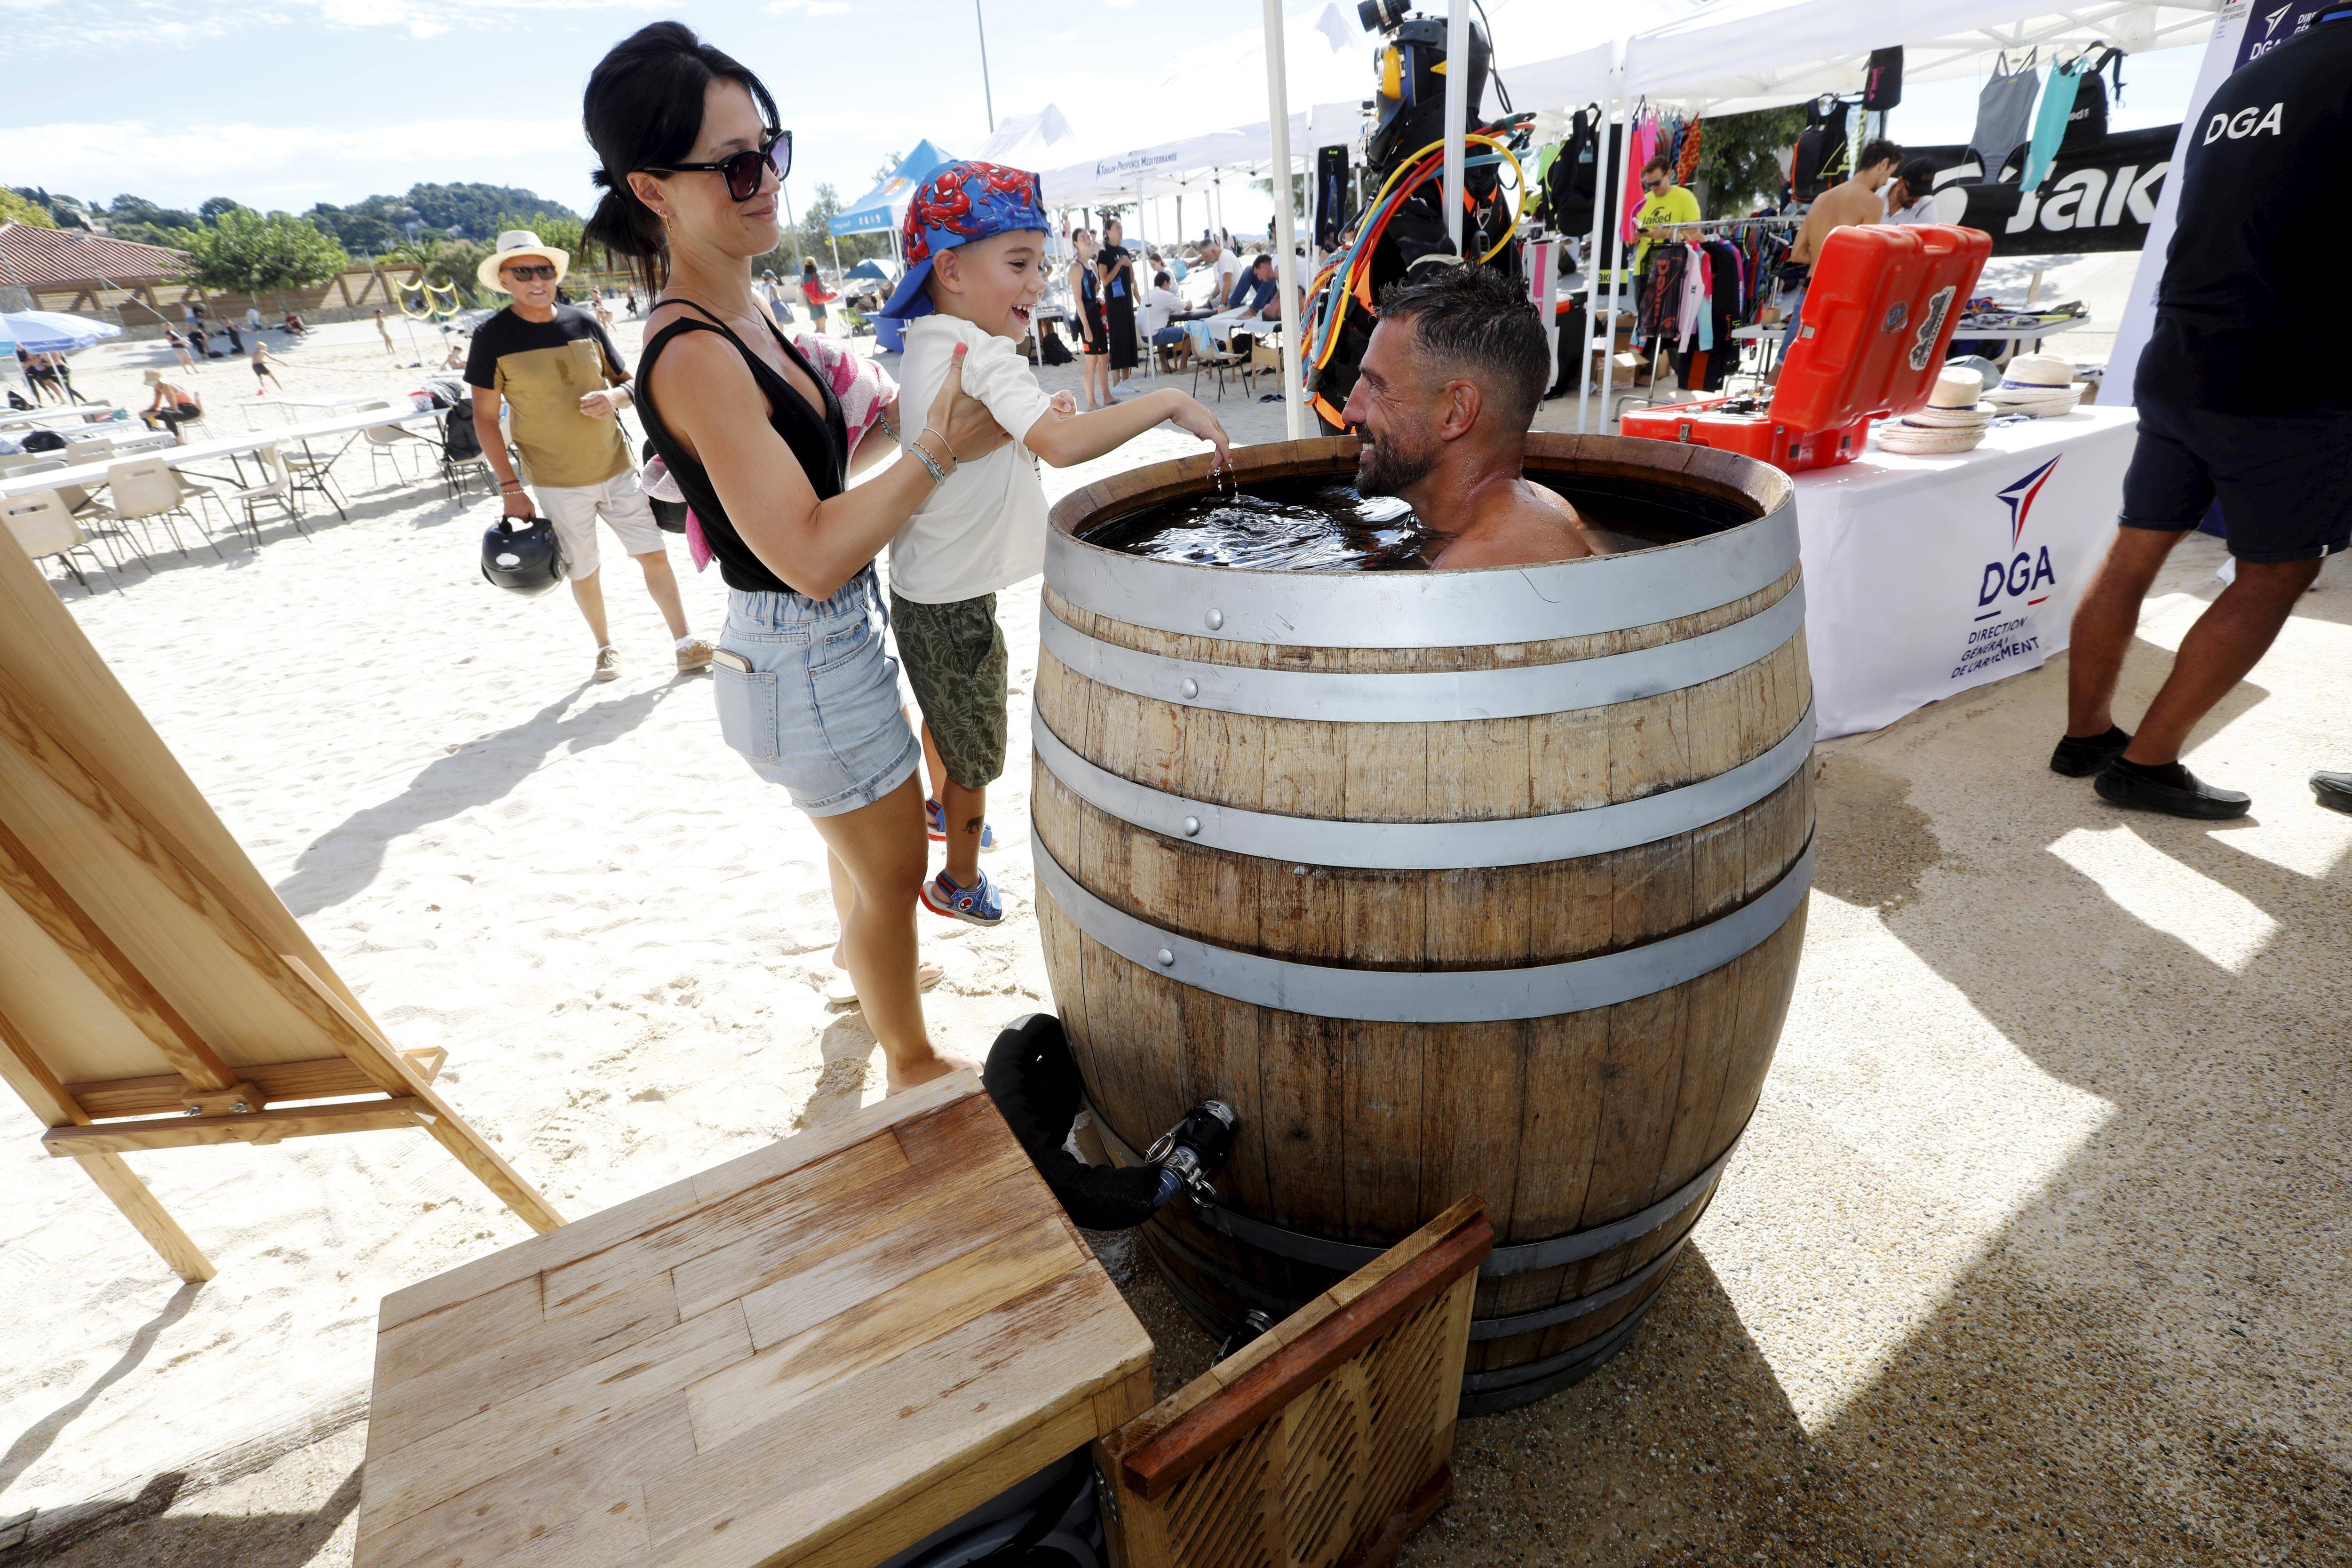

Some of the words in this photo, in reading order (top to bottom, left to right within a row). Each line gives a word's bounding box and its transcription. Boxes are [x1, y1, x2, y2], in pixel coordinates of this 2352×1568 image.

[2203, 103, 2284, 146] DGA
[1978, 545, 2056, 607] DGA
[1968, 616, 2028, 645] DIRECTION
[1951, 665, 1968, 678] DE
